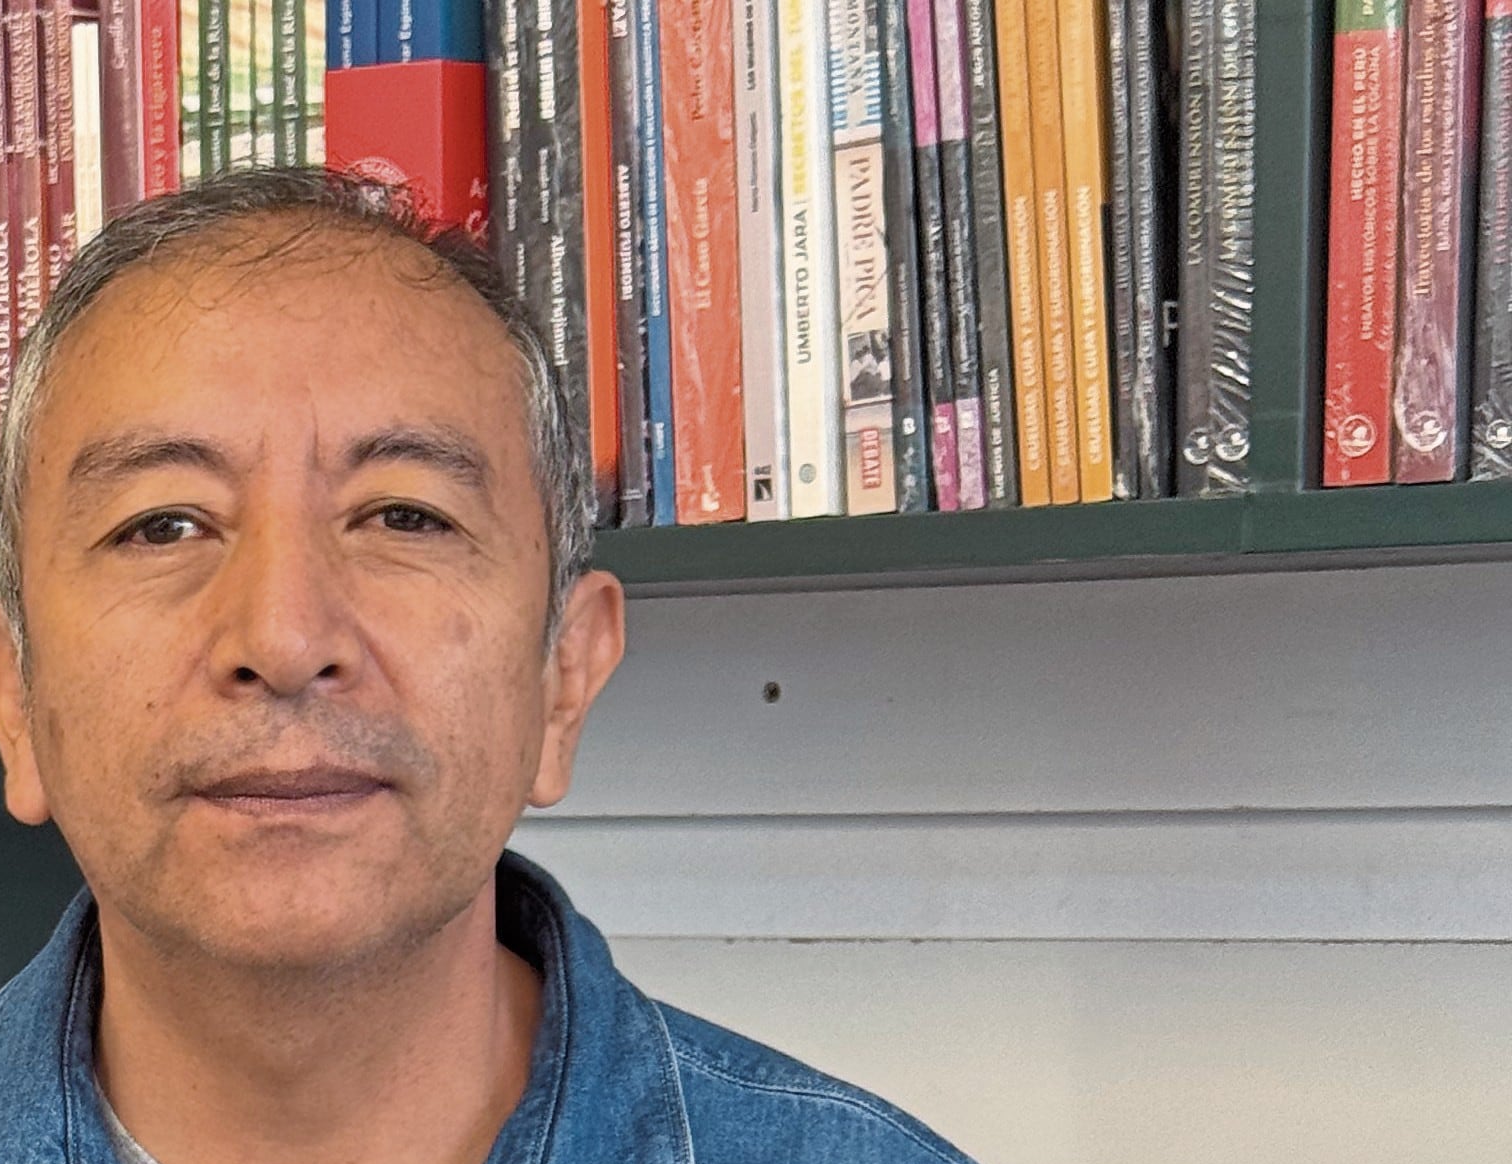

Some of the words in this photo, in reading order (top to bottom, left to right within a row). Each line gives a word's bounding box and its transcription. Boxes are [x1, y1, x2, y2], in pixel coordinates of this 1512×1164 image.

[1350, 48, 1367, 91] PERÚ
[1365, 46, 1382, 110] COCAÍNA
[1351, 119, 1365, 141] EN
[1353, 95, 1366, 114] EL
[1367, 114, 1380, 134] LA
[1187, 88, 1204, 238] COMPRENSIÓN
[1351, 143, 1366, 201] HECHO
[1365, 138, 1380, 184] SOBRE
[1412, 159, 1431, 183] de
[617, 164, 631, 229] ALBERTO
[692, 177, 710, 238] García
[849, 155, 876, 250] PADRE
[794, 210, 809, 262] JARA
[1013, 197, 1034, 320] SUBORDINACIÓN
[1076, 187, 1095, 317] SUBORDINACIÓN
[1360, 187, 1378, 273] HISTÓRICOS
[24, 217, 40, 309] PIEROLA
[550, 235, 568, 294] Alberto
[620, 232, 634, 299] FUJIMORI
[695, 241, 711, 287] Caso
[695, 289, 711, 309] El
[796, 266, 813, 364] UMBERTO
[1360, 278, 1375, 340] ENSAYOS
[551, 298, 569, 367] Fujimori
[1022, 335, 1038, 386] CULPA
[862, 430, 881, 489] DEBATE
